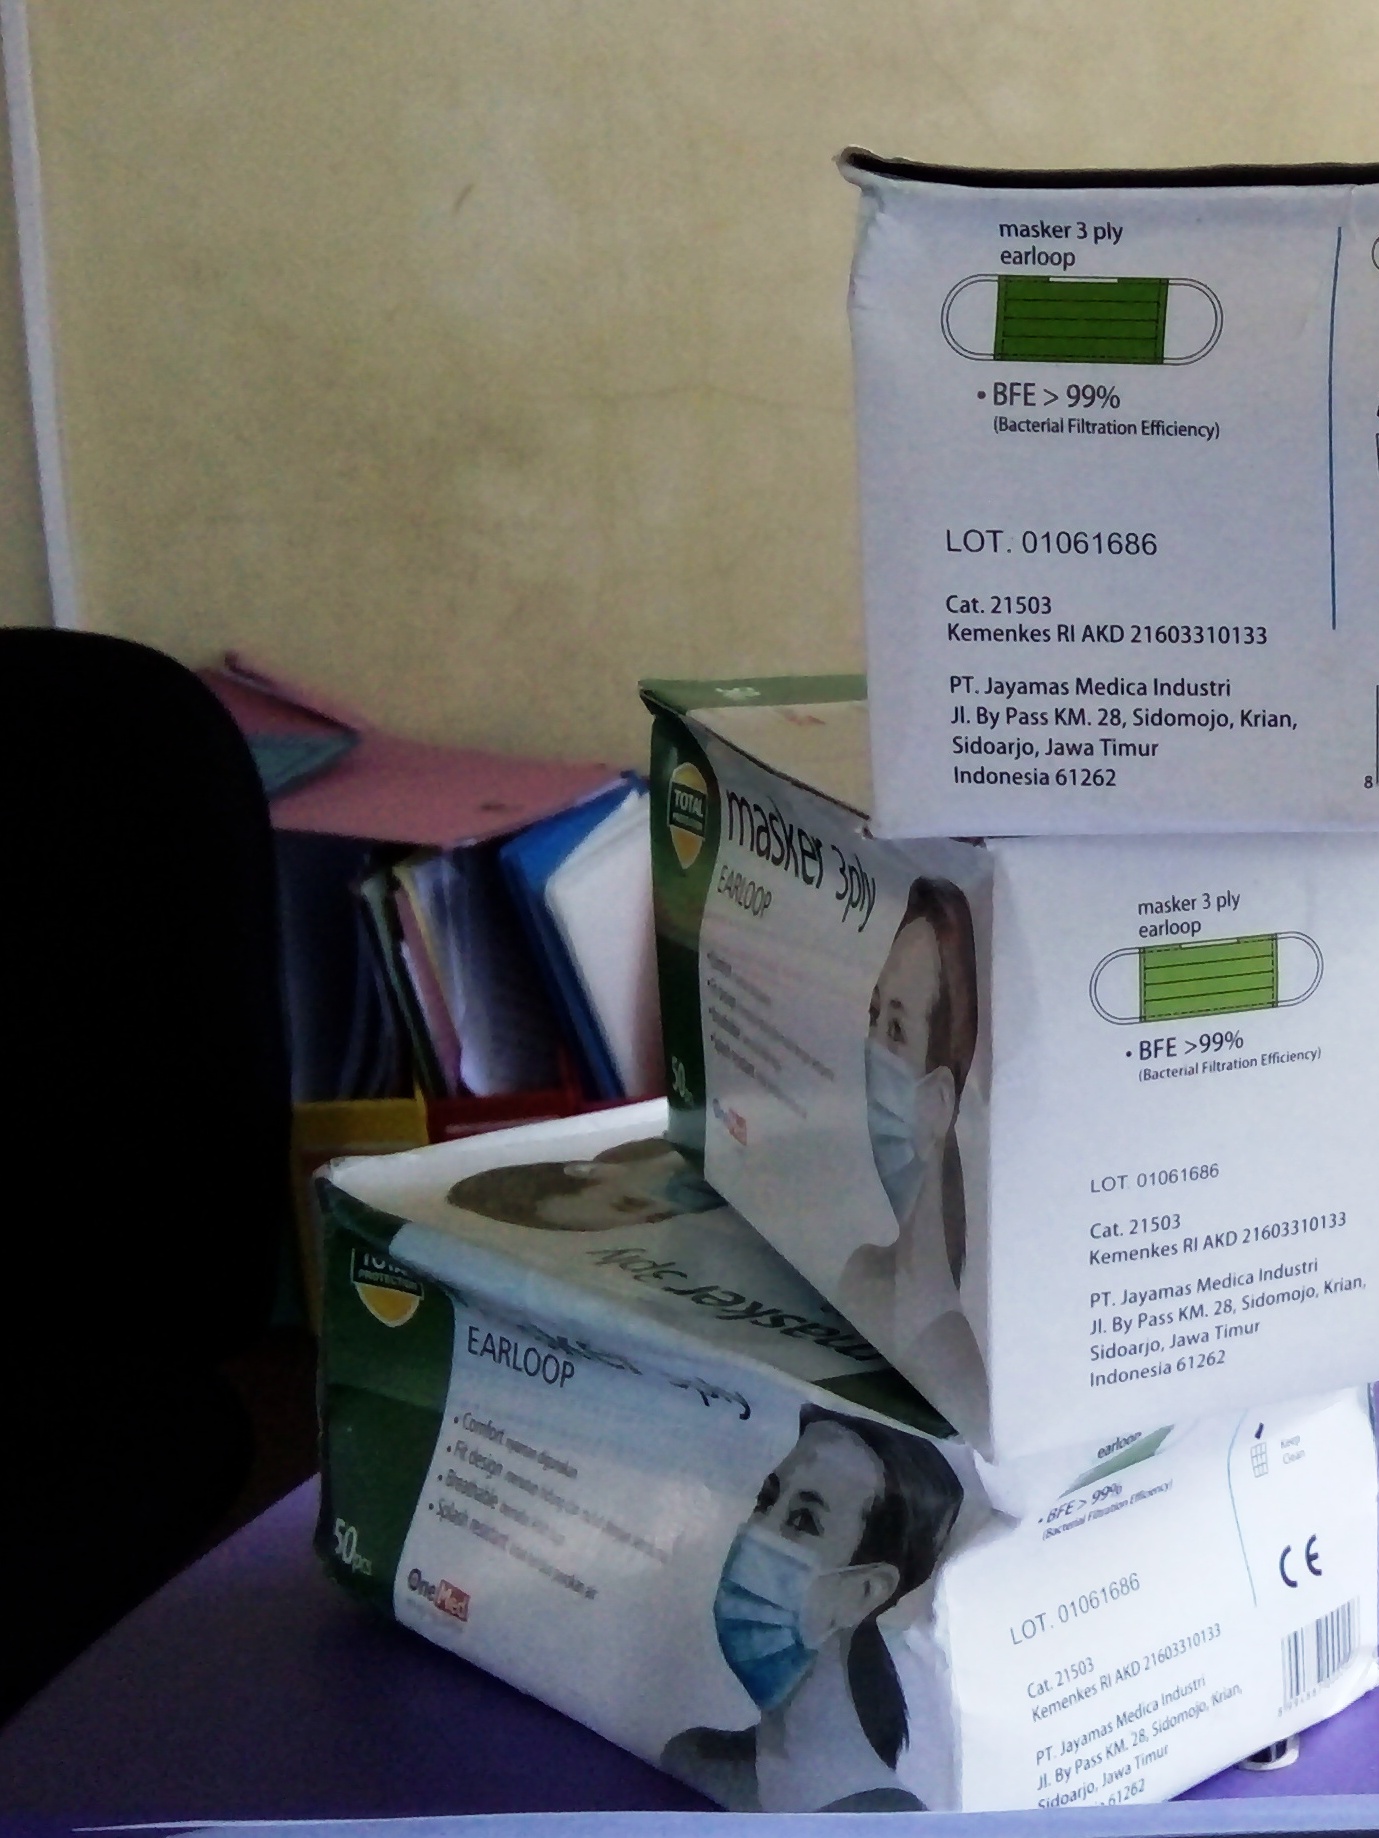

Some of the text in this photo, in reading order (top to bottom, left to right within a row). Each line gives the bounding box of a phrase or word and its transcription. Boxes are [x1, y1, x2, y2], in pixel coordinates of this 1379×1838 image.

[998, 219, 1124, 246] masker 3 ply
[999, 245, 1076, 270] earloop
[992, 381, 1121, 410] BFE > 99%
[993, 415, 1221, 443] (Bacterial Filtration Efficiency)
[946, 528, 1158, 556] LOT. 01061686
[945, 594, 1052, 615] Cat. 21503
[947, 622, 1268, 646] Kemenkes RI AKD 21603310133
[949, 674, 1231, 700] PT. Jayamas Medica Industri
[950, 704, 1298, 733] Jl. By Pass KM. 28, Sidomojo, Krian,
[952, 735, 1160, 761] Sidoarjo, Jawa Timur
[953, 765, 1117, 787] Indonesia 61262
[1363, 774, 1374, 790] 8
[726, 788, 824, 889] masker
[716, 864, 773, 919] EARLOOP
[1137, 889, 1241, 916] masker 3 ply
[1138, 918, 1202, 939] earloop
[1138, 1029, 1245, 1061] BFE >99%
[1138, 1046, 1322, 1083] (Bacterial Filtration Efficiency)
[1136, 1162, 1220, 1189] 01061686
[1089, 1213, 1181, 1240] Cat. 21503
[1089, 1211, 1347, 1266] Kemenkes RI AKD 21603310133
[1090, 1257, 1318, 1309] PT. Jayamas Medica Industri
[1089, 1277, 1367, 1336] Jl. By Pass KM. 28, Sidomojo, Krian,
[662, 1284, 885, 1362] masker
[467, 1324, 575, 1388] EARLOOP
[1089, 1321, 1261, 1362] Sidoarjo, Jawa Timur
[1090, 1349, 1226, 1388] Indonesia 61262
[1046, 1500, 1075, 1523] BFE
[1278, 1532, 1323, 1589] CE
[1009, 1572, 1141, 1646] LOT. 01061686
[1031, 1624, 1222, 1724] Kemenkes RI AKD 21603310133
[1054, 1658, 1095, 1688] 21503
[1059, 1720, 1114, 1757] Jayamas
[1115, 1699, 1159, 1730] Medica
[1160, 1675, 1207, 1707] Industri
[1054, 1766, 1073, 1784] By
[1074, 1751, 1103, 1775] Pass
[1101, 1763, 1132, 1788] Jawa
[1134, 1745, 1169, 1770] Timur
[1108, 1777, 1146, 1805] 61262
